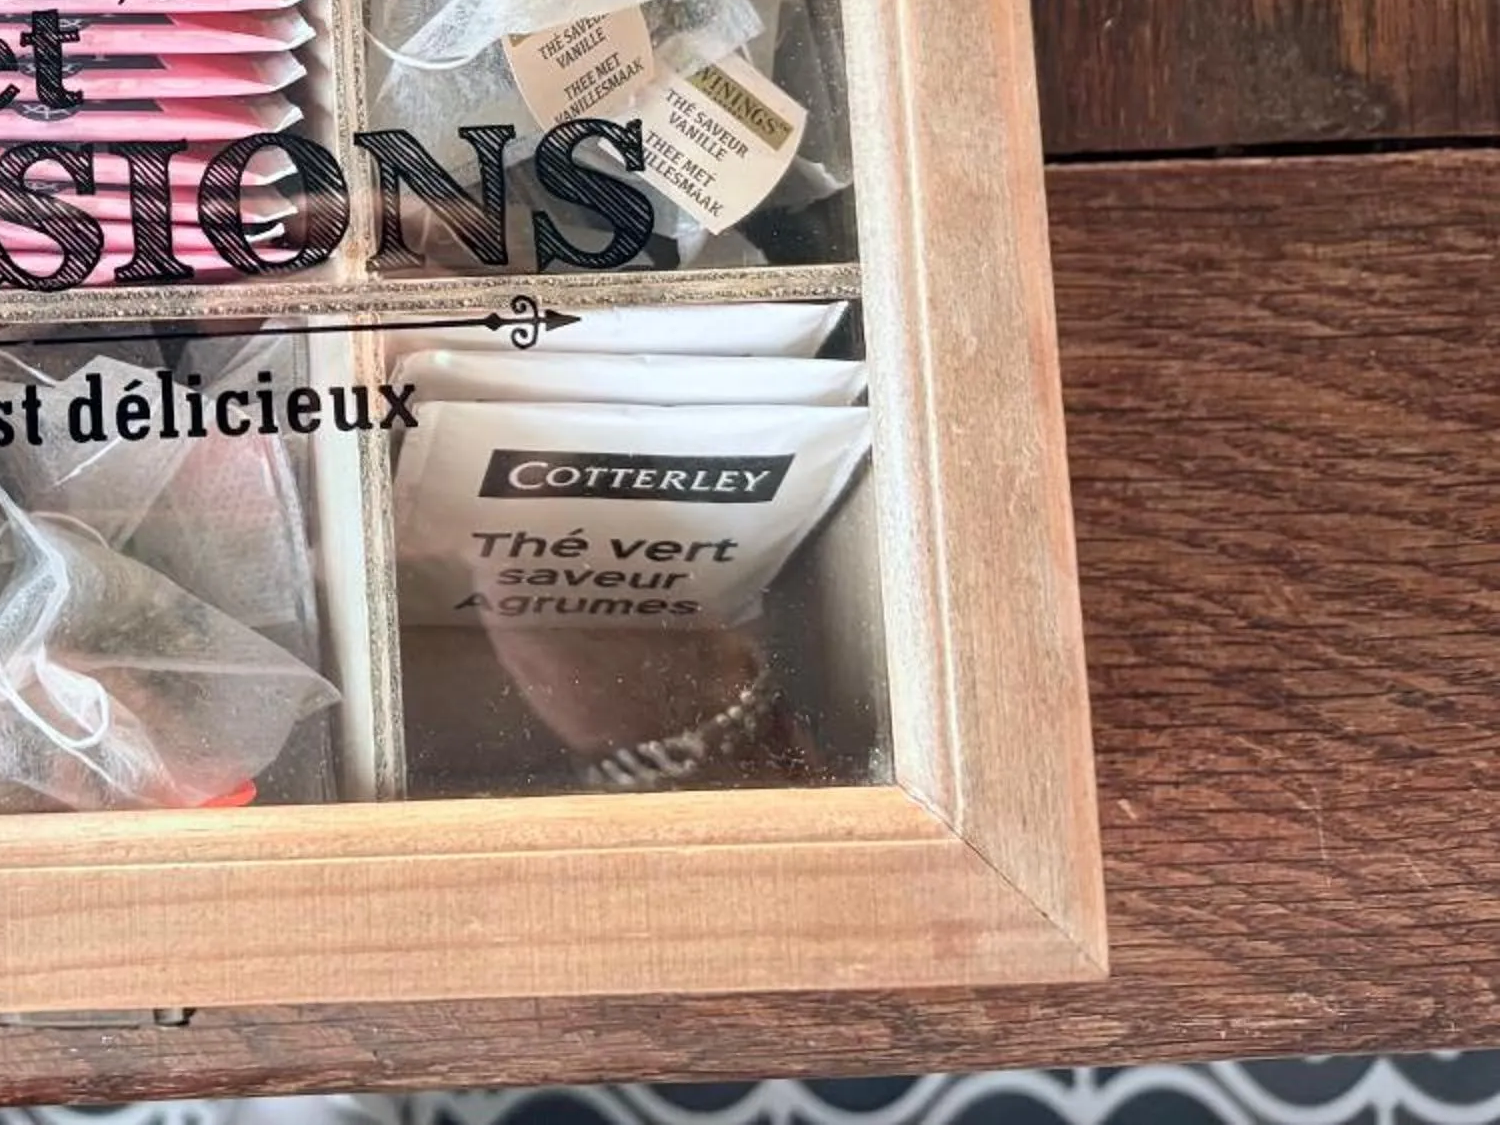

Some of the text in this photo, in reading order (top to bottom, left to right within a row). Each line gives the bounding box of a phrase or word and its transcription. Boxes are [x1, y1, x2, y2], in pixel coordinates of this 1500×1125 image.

[537, 13, 610, 60] THÉ SAVE
[555, 26, 607, 69] VANILLE
[554, 57, 645, 124] VANILLESMAAK
[563, 51, 621, 101] THEE MET
[666, 87, 697, 119] THÉ
[692, 110, 750, 159] SAVEUR
[668, 110, 729, 162] VANILLE
[645, 130, 718, 188] THEE MET
[67, 370, 420, 443] délicieux
[508, 461, 771, 493] COTTERLEY
[470, 527, 740, 562] Thé vert
[496, 567, 692, 590] saveur
[453, 590, 702, 616] Agrumes
